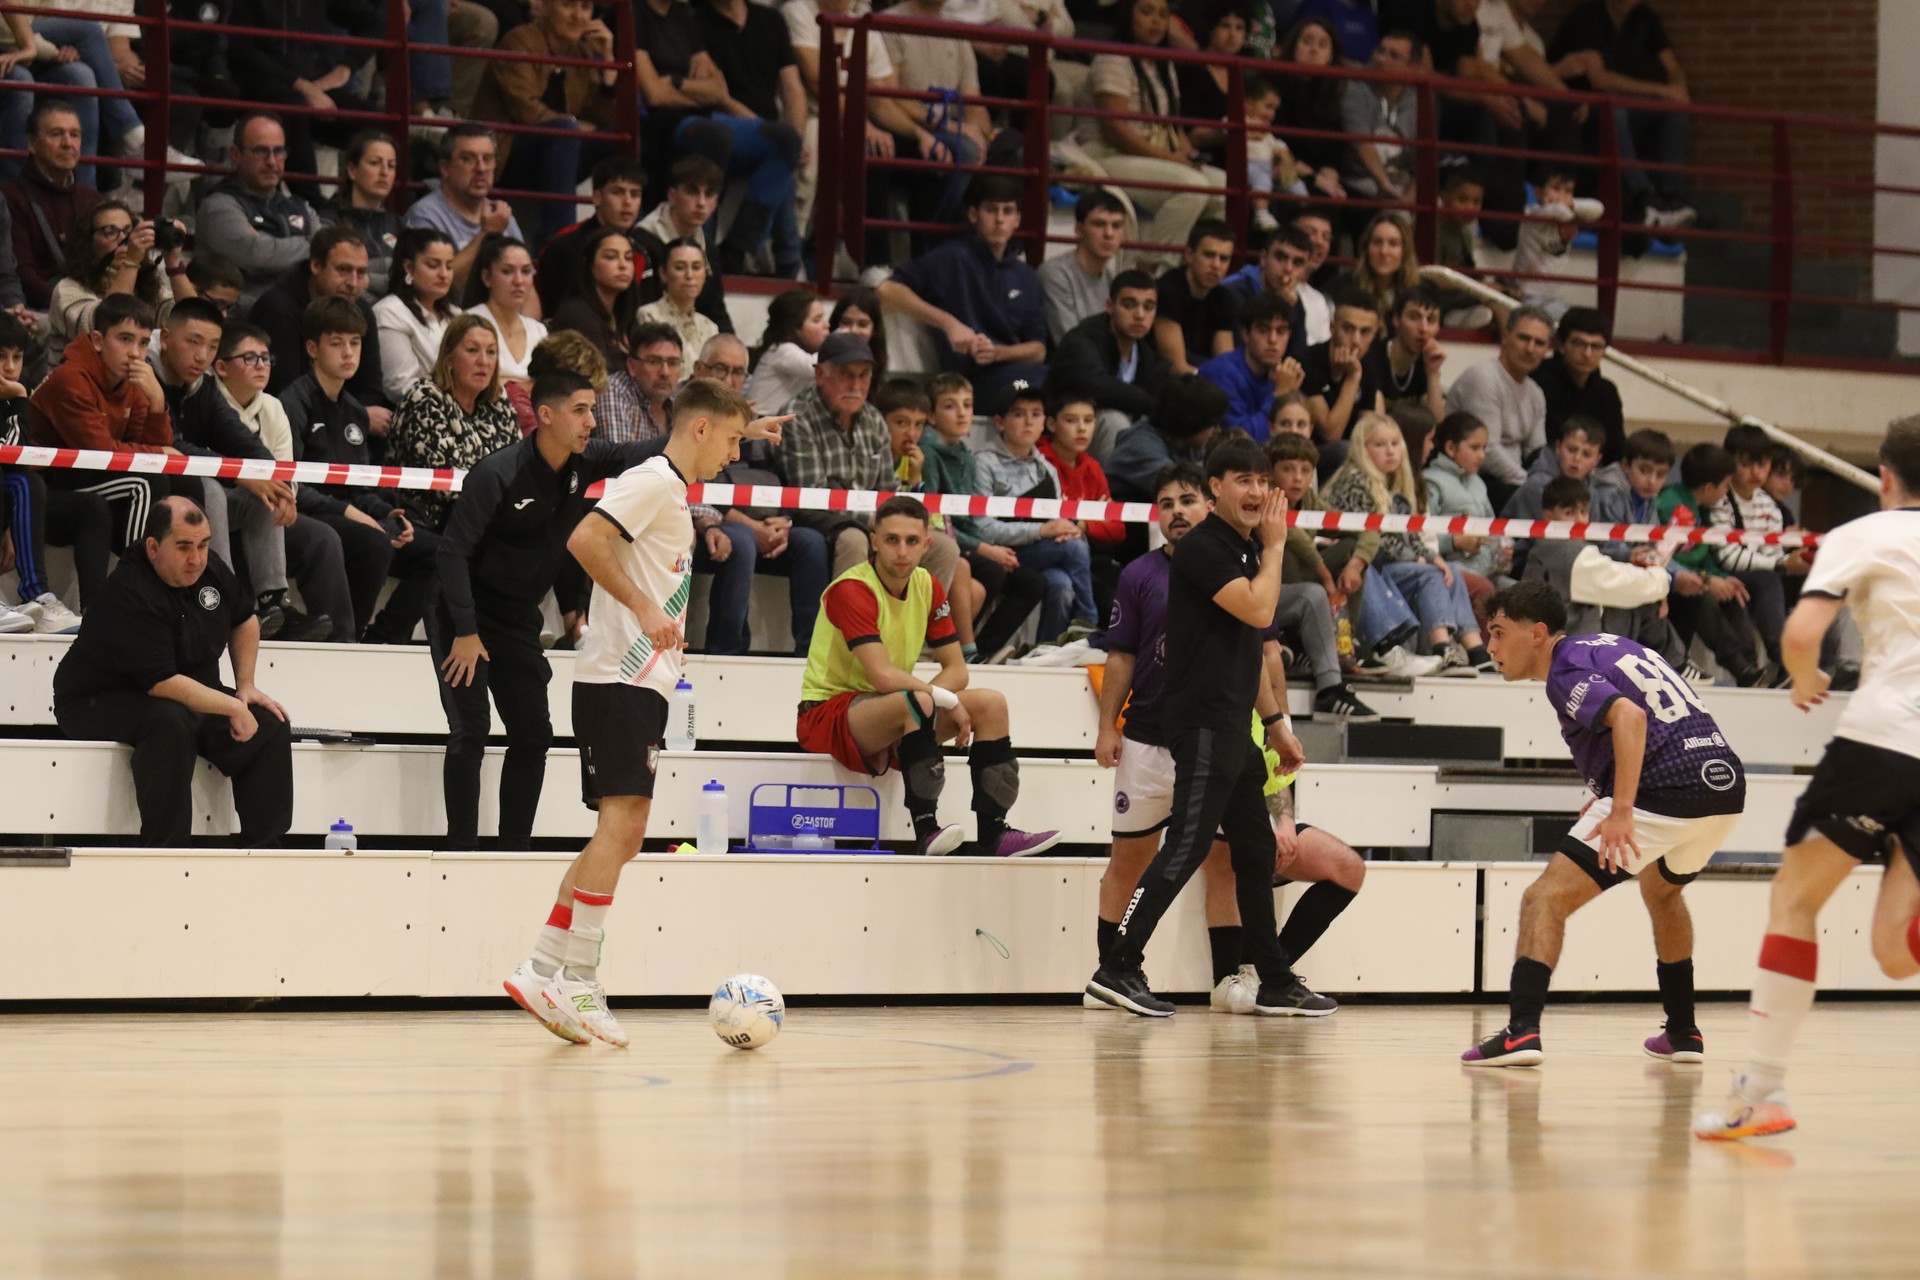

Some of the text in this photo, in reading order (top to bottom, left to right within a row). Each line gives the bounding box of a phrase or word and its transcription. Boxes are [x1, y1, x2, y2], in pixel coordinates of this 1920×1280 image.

[687, 704, 695, 729] ZASTOR
[1683, 736, 1715, 751] Allianz
[804, 816, 836, 829] ZASTOR
